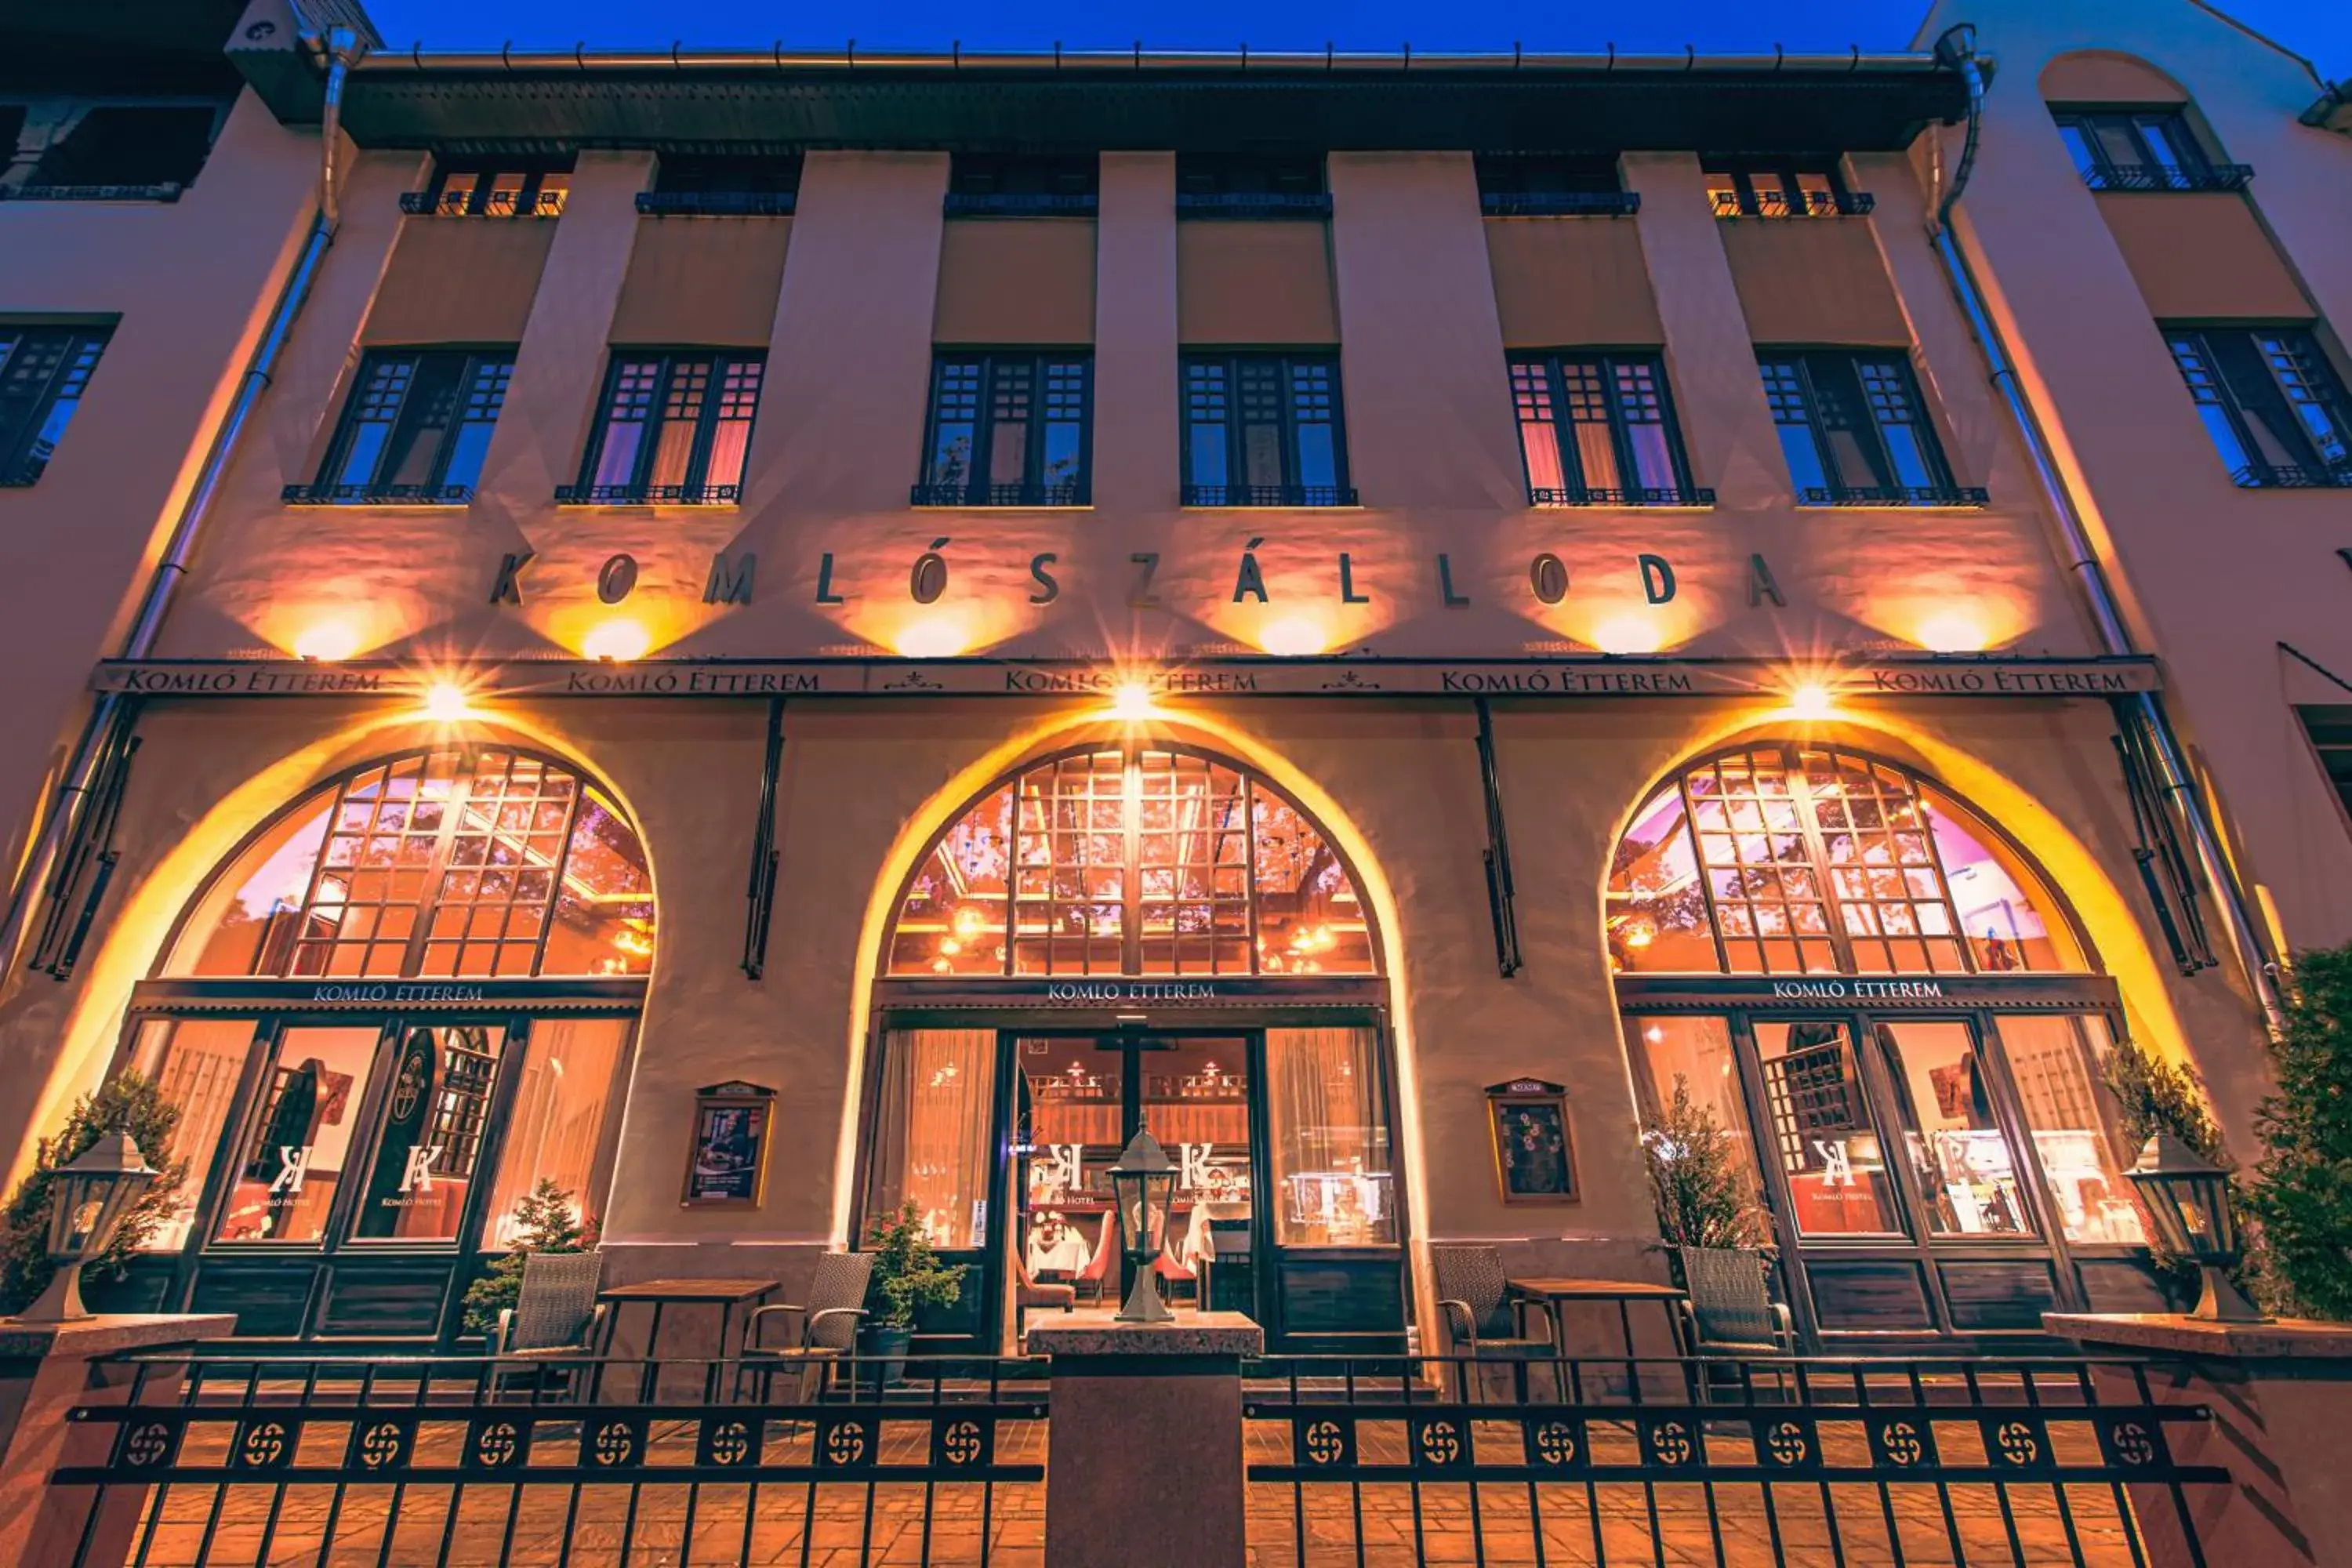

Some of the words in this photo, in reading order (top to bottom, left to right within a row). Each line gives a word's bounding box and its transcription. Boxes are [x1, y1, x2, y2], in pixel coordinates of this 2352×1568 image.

[124, 669, 236, 691] KOMLÓ
[567, 670, 677, 691] KOMLÓ
[689, 666, 820, 691] ÉTTEREM
[1442, 670, 1549, 690] KOMLÓ
[1562, 667, 1693, 691] ÉTTEREM
[1873, 670, 1984, 690] KOMLÓ
[1996, 666, 2128, 691] ÉTTEREM
[1773, 980, 1845, 998] KOMLÓ
[1853, 980, 1943, 998] ÉTTEREM
